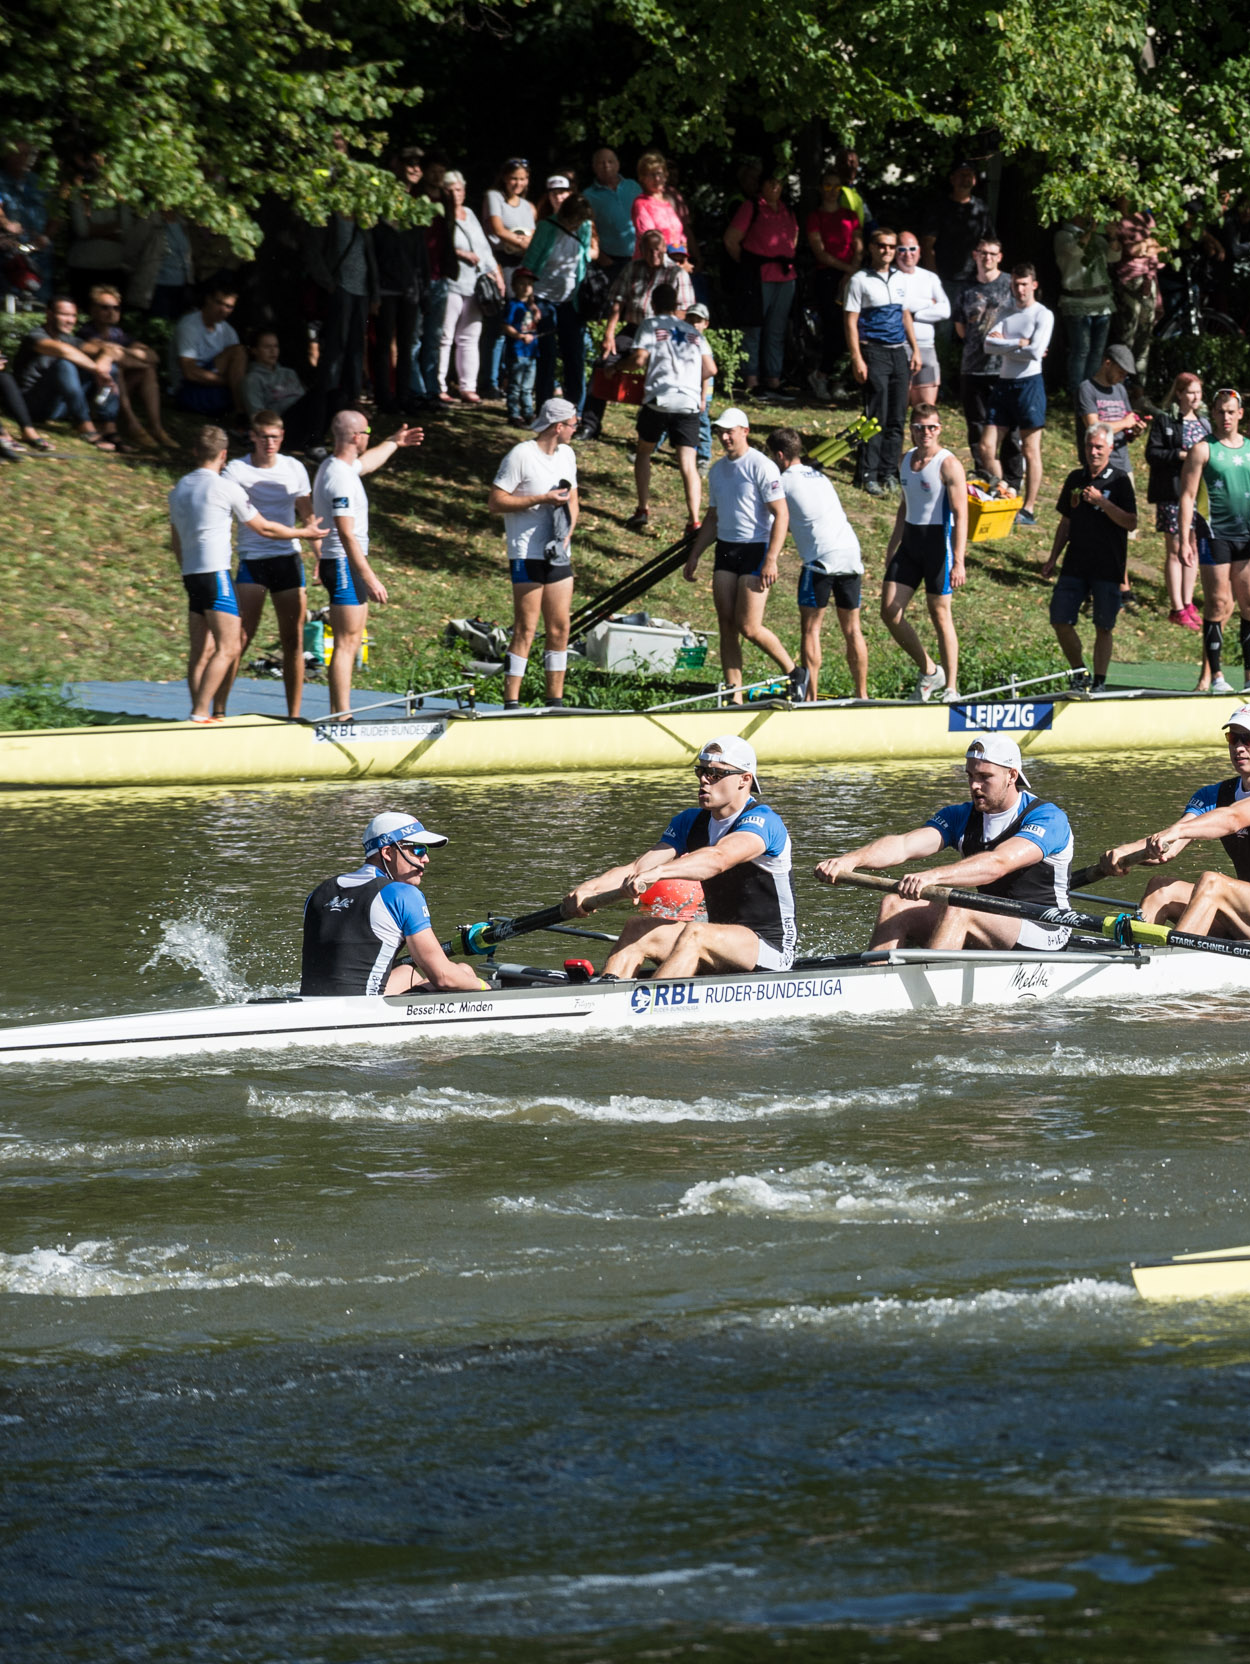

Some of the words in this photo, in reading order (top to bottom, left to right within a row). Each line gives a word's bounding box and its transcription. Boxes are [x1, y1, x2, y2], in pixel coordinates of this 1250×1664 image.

[965, 703, 1035, 729] LEIPZIG
[330, 723, 357, 737] RBL
[360, 723, 445, 737] RUDER-BUNDESLIGA
[379, 834, 393, 846] NK
[400, 826, 417, 837] NK
[1040, 907, 1082, 927] Melitta
[1170, 935, 1196, 947] STARK.
[1197, 940, 1232, 954] SCHNELL.
[1233, 947, 1250, 957] GUT.
[1006, 962, 1049, 990] Melitta
[654, 982, 700, 1006] RBL
[705, 978, 843, 1004] RUDER-BUNDESLIGA
[406, 1003, 457, 1016] Bessel-R.C.
[458, 1001, 494, 1013] Minden
